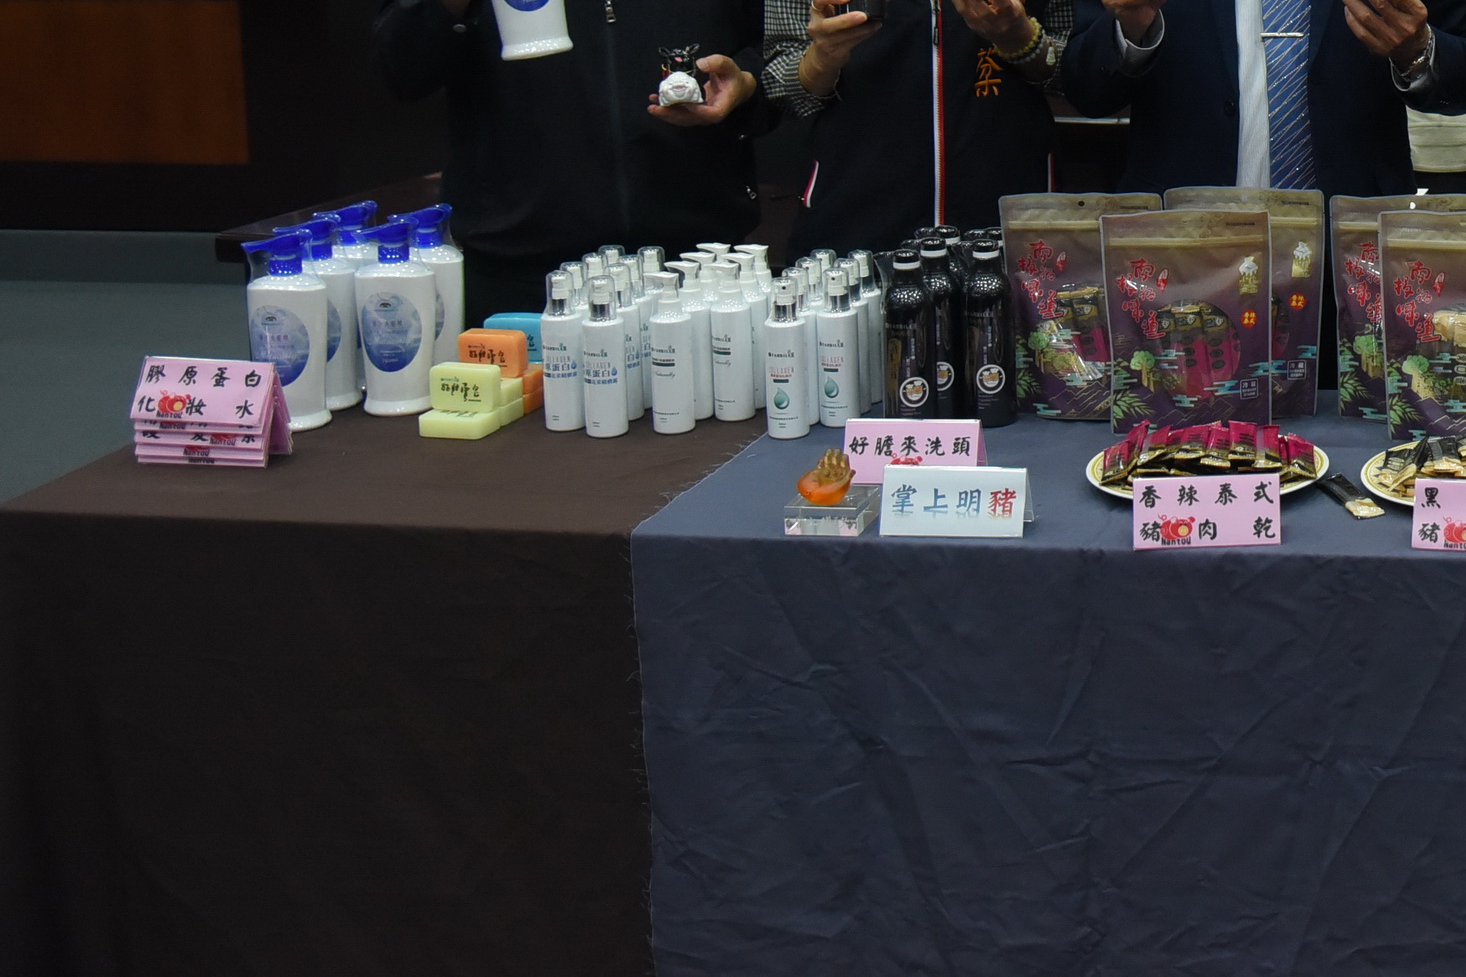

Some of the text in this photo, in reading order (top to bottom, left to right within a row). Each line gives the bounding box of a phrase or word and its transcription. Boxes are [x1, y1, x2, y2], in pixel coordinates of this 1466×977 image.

[145, 365, 261, 388] 膠原蛋白
[138, 395, 254, 418] 化妝水
[848, 435, 971, 457] 好膽來洗頭
[891, 484, 1016, 515] 掌上明豬
[1139, 481, 1274, 508] 香辣泰式
[1139, 516, 1276, 542] 豬肉乾
